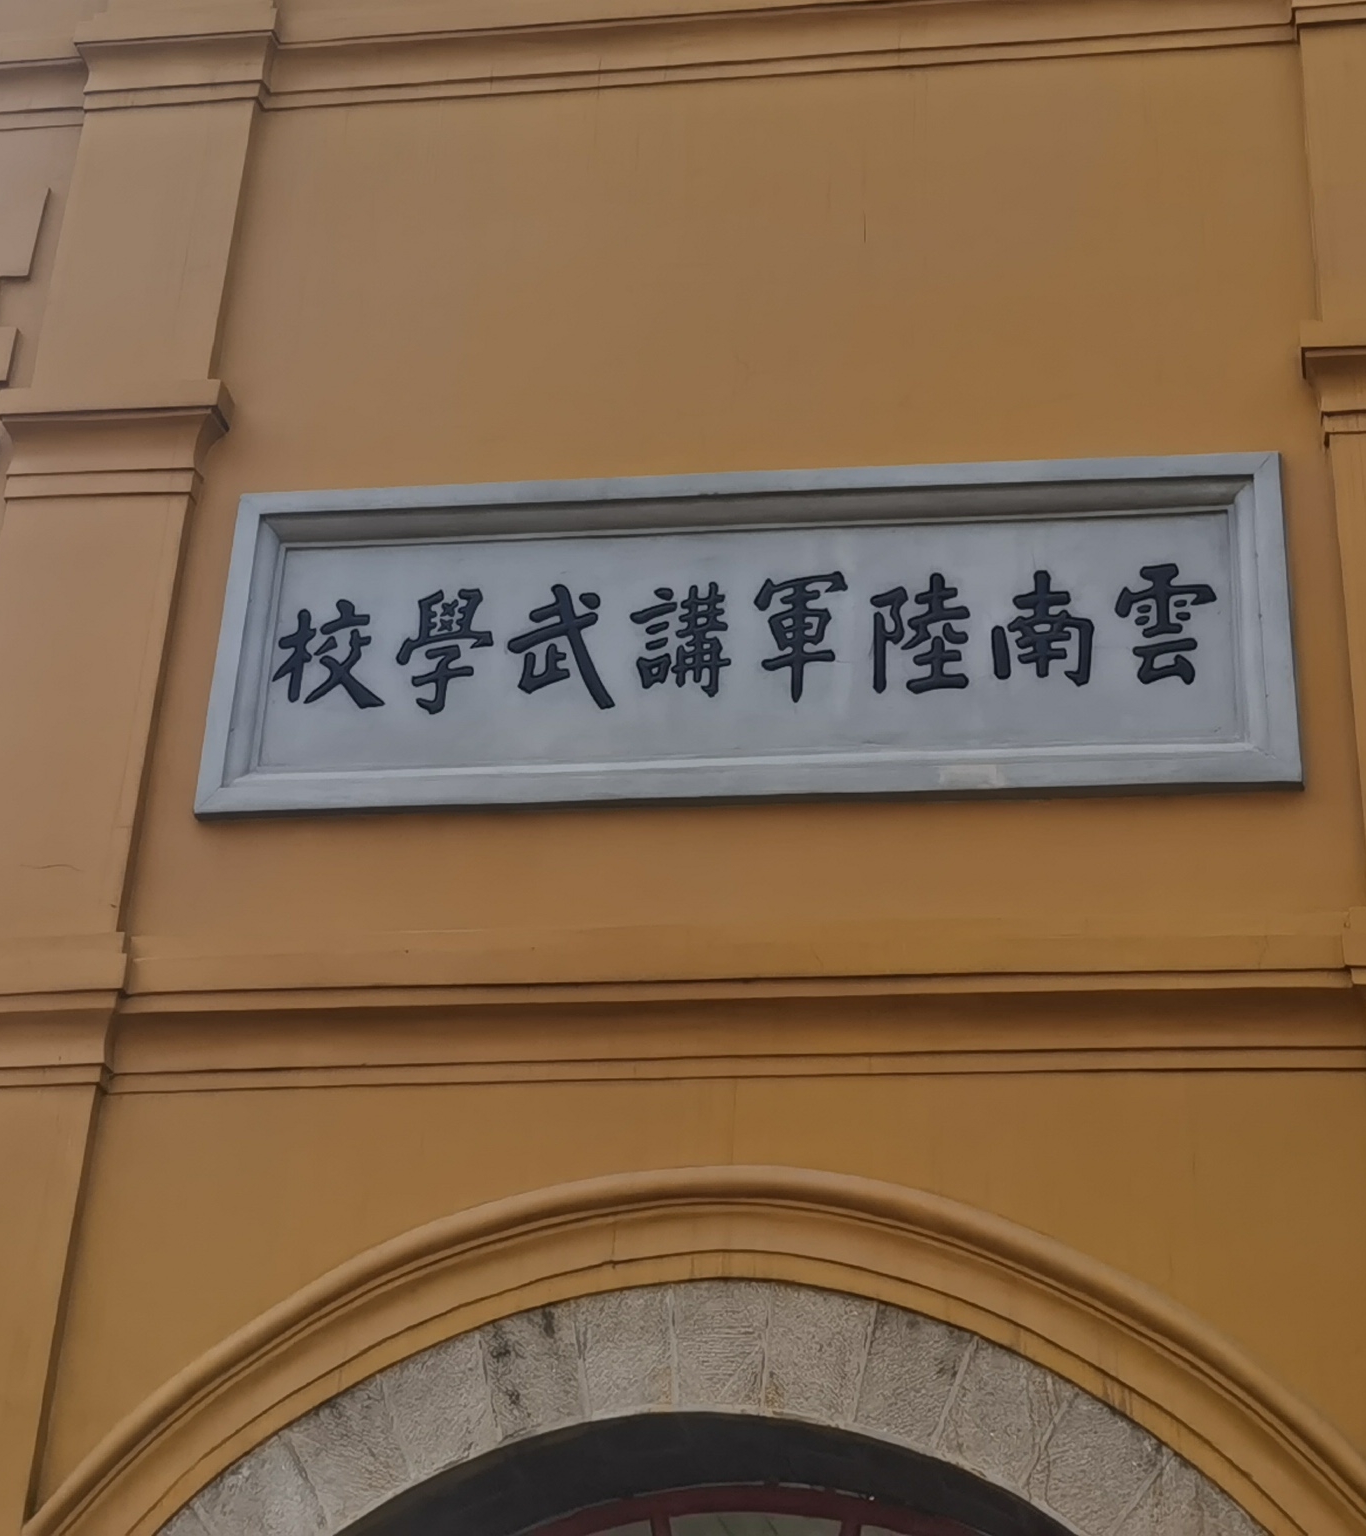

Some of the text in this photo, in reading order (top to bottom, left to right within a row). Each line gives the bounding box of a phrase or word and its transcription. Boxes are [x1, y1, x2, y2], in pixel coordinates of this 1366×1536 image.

[271, 562, 1218, 715] 雲南陸軍講武學校
